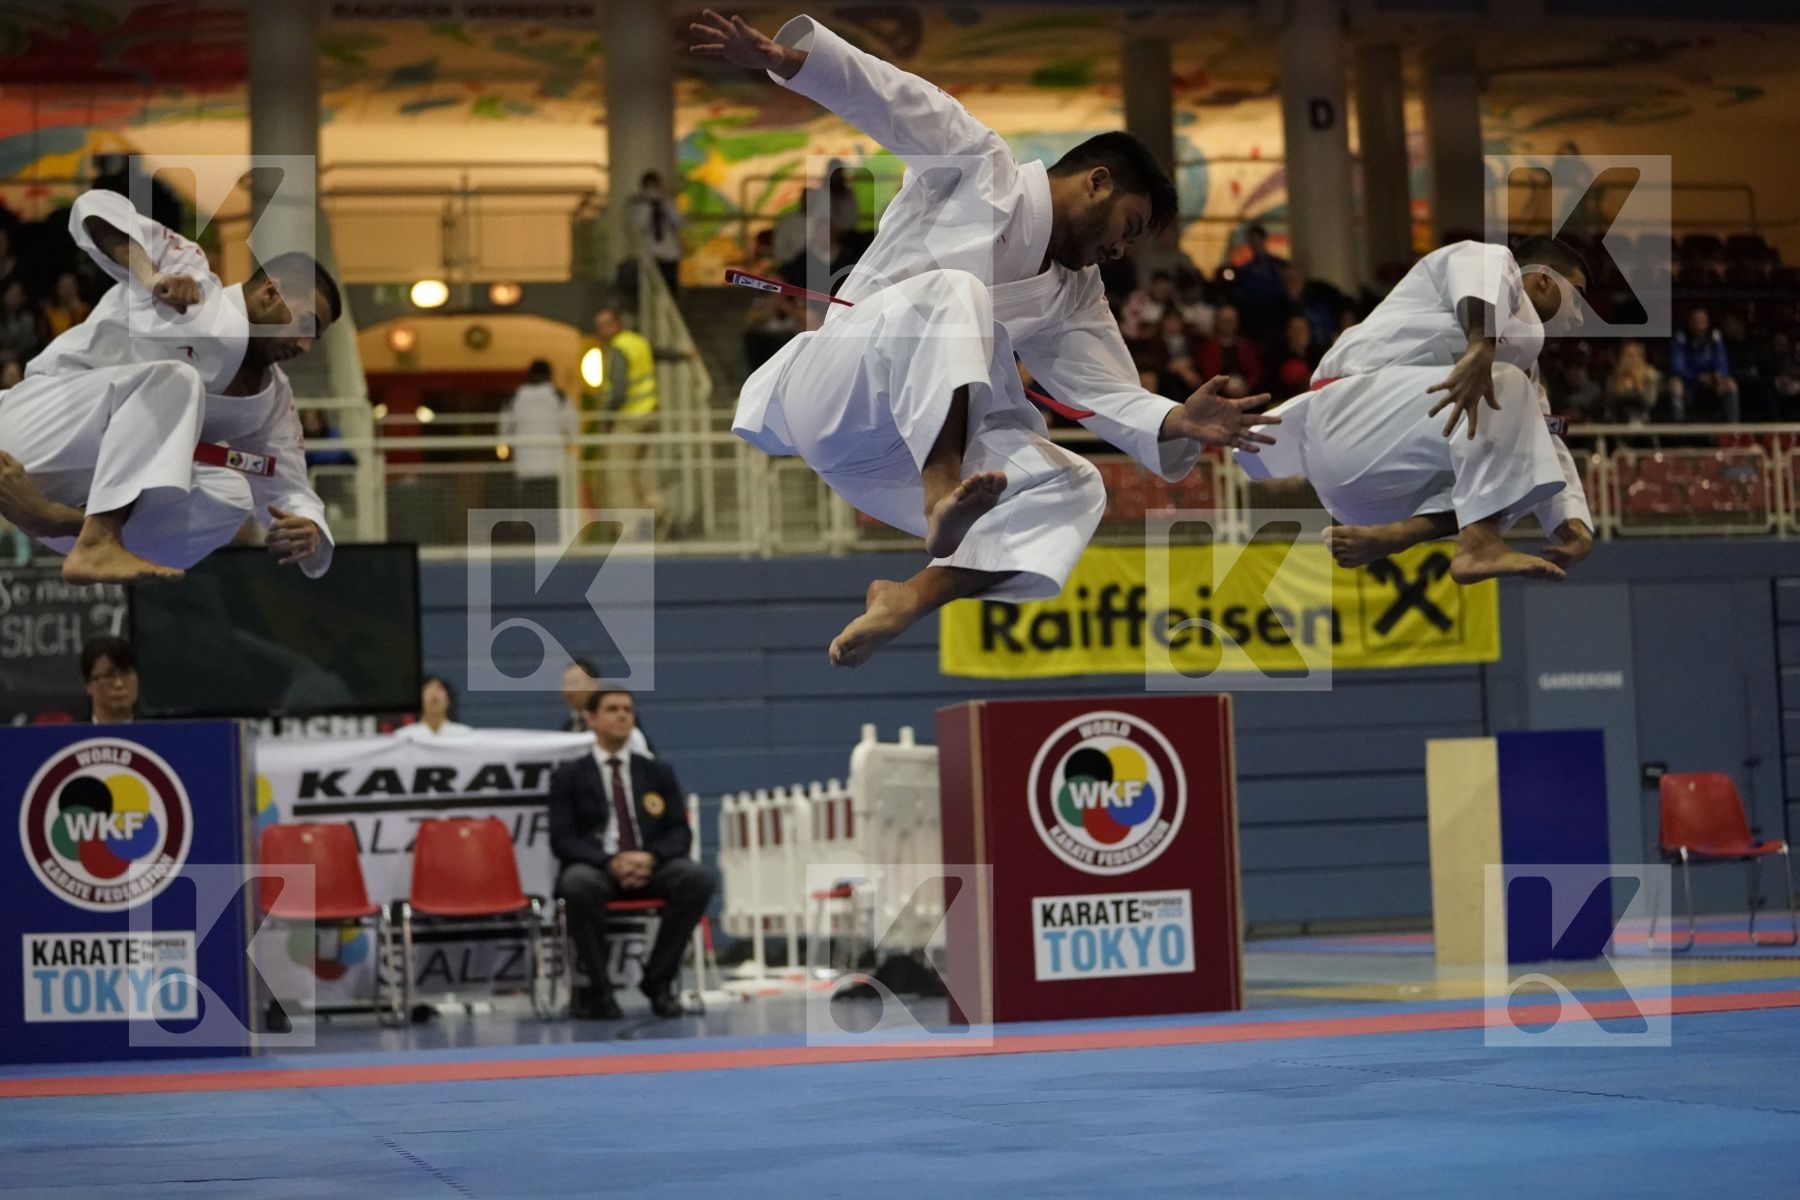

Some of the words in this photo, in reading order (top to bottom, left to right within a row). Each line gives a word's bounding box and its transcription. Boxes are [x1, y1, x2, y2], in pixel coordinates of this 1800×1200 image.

[1309, 98, 1334, 131] D
[980, 583, 1343, 654] Raiffeisen
[1078, 720, 1132, 738] WORLD
[75, 747, 133, 766] WORLD
[299, 762, 556, 799] KARAT
[1068, 780, 1143, 809] WKF
[63, 811, 145, 842] WKF
[1049, 824, 1096, 865] KARATE
[1096, 819, 1171, 866] FEDERATION
[41, 857, 93, 902] KARATE
[93, 853, 176, 902] FEDERATION
[1041, 899, 1141, 928] KARATE
[32, 939, 139, 967] KARATE
[1043, 923, 1186, 973] TOKYO
[32, 966, 188, 1015] TOKYO
